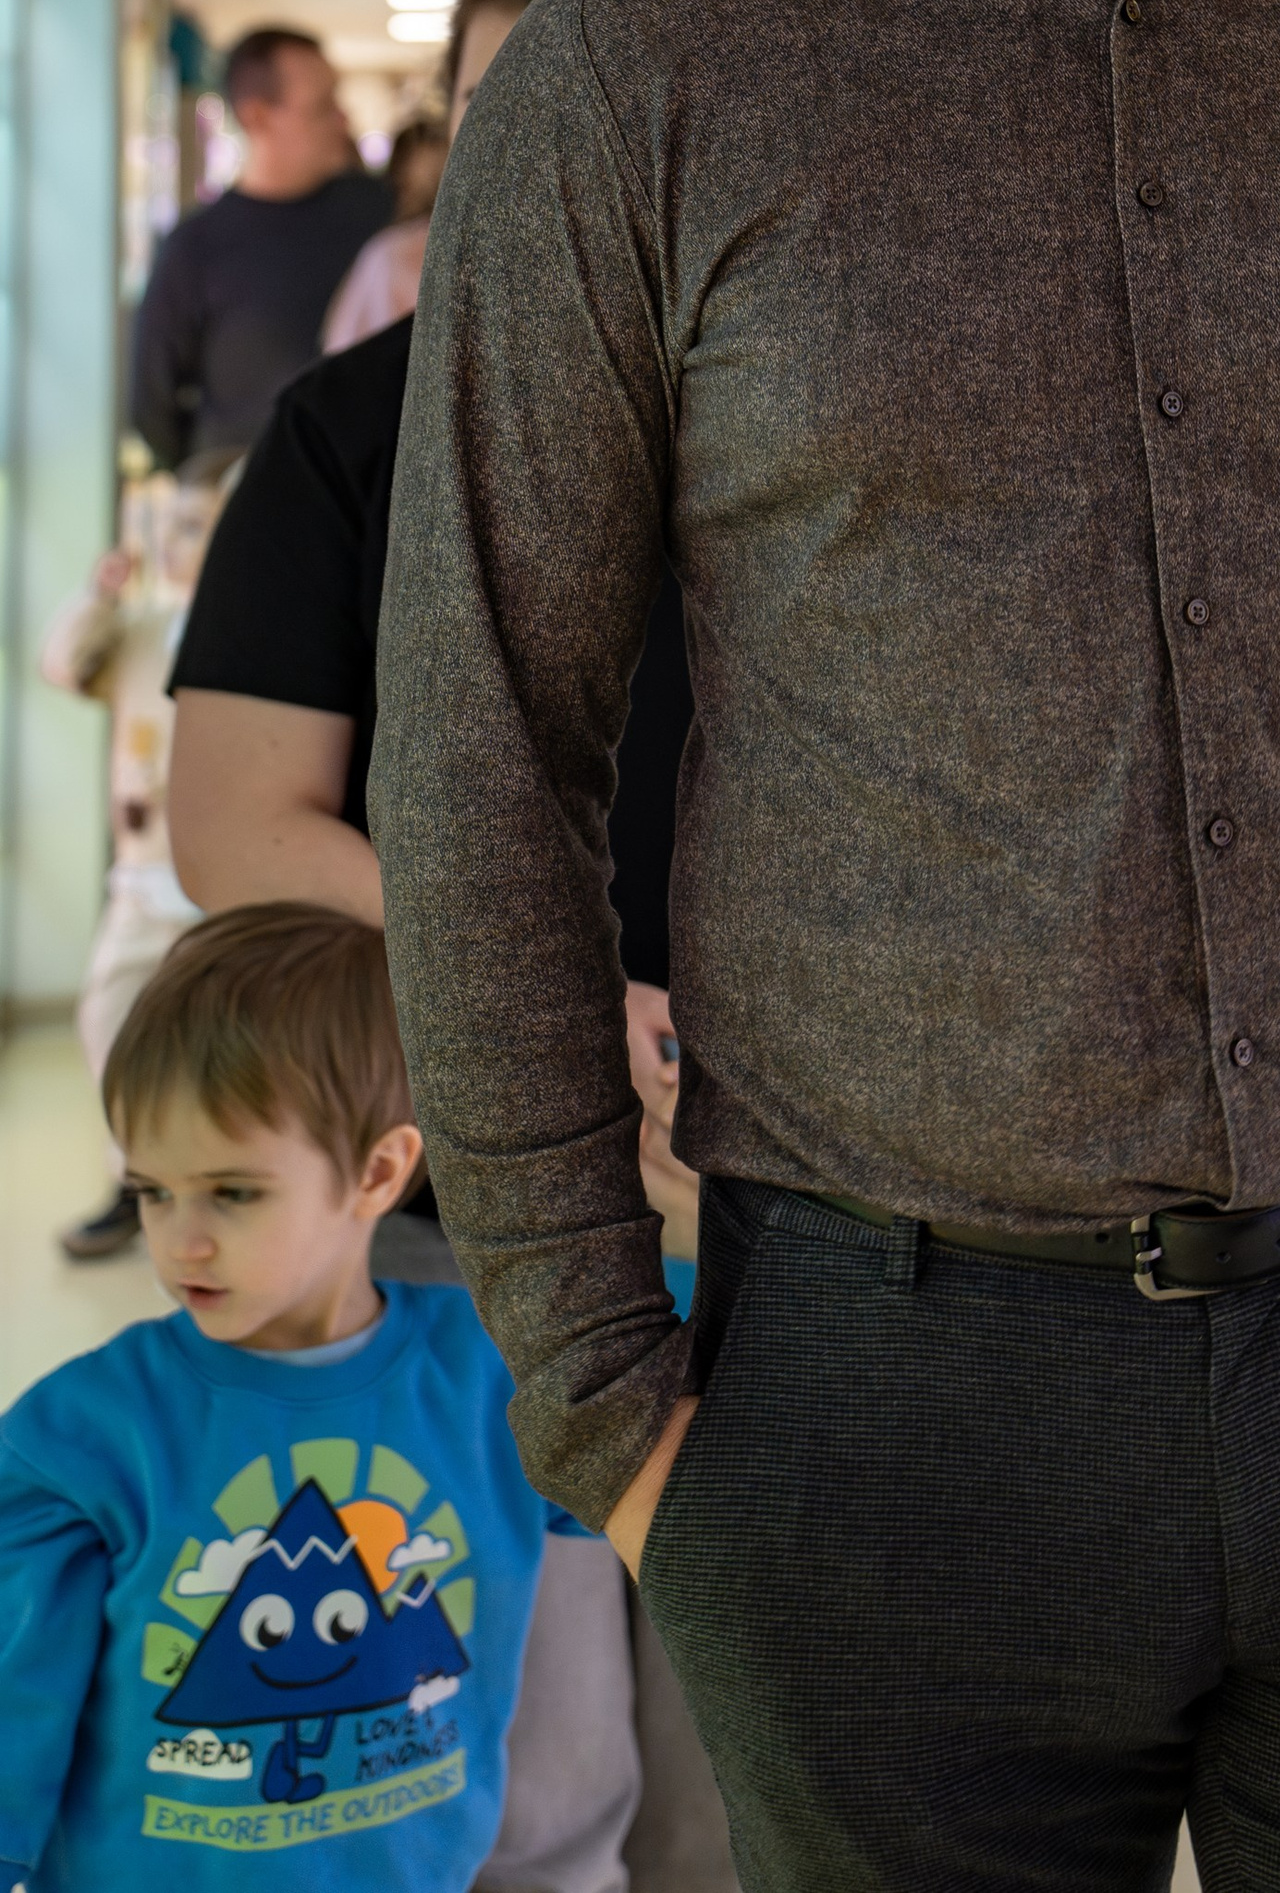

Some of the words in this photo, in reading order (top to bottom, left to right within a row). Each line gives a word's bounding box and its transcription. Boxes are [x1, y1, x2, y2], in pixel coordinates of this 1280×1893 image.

[156, 1736, 253, 1767] SPREAD
[155, 1806, 271, 1844] EXPLORE
[279, 1802, 336, 1838] THE
